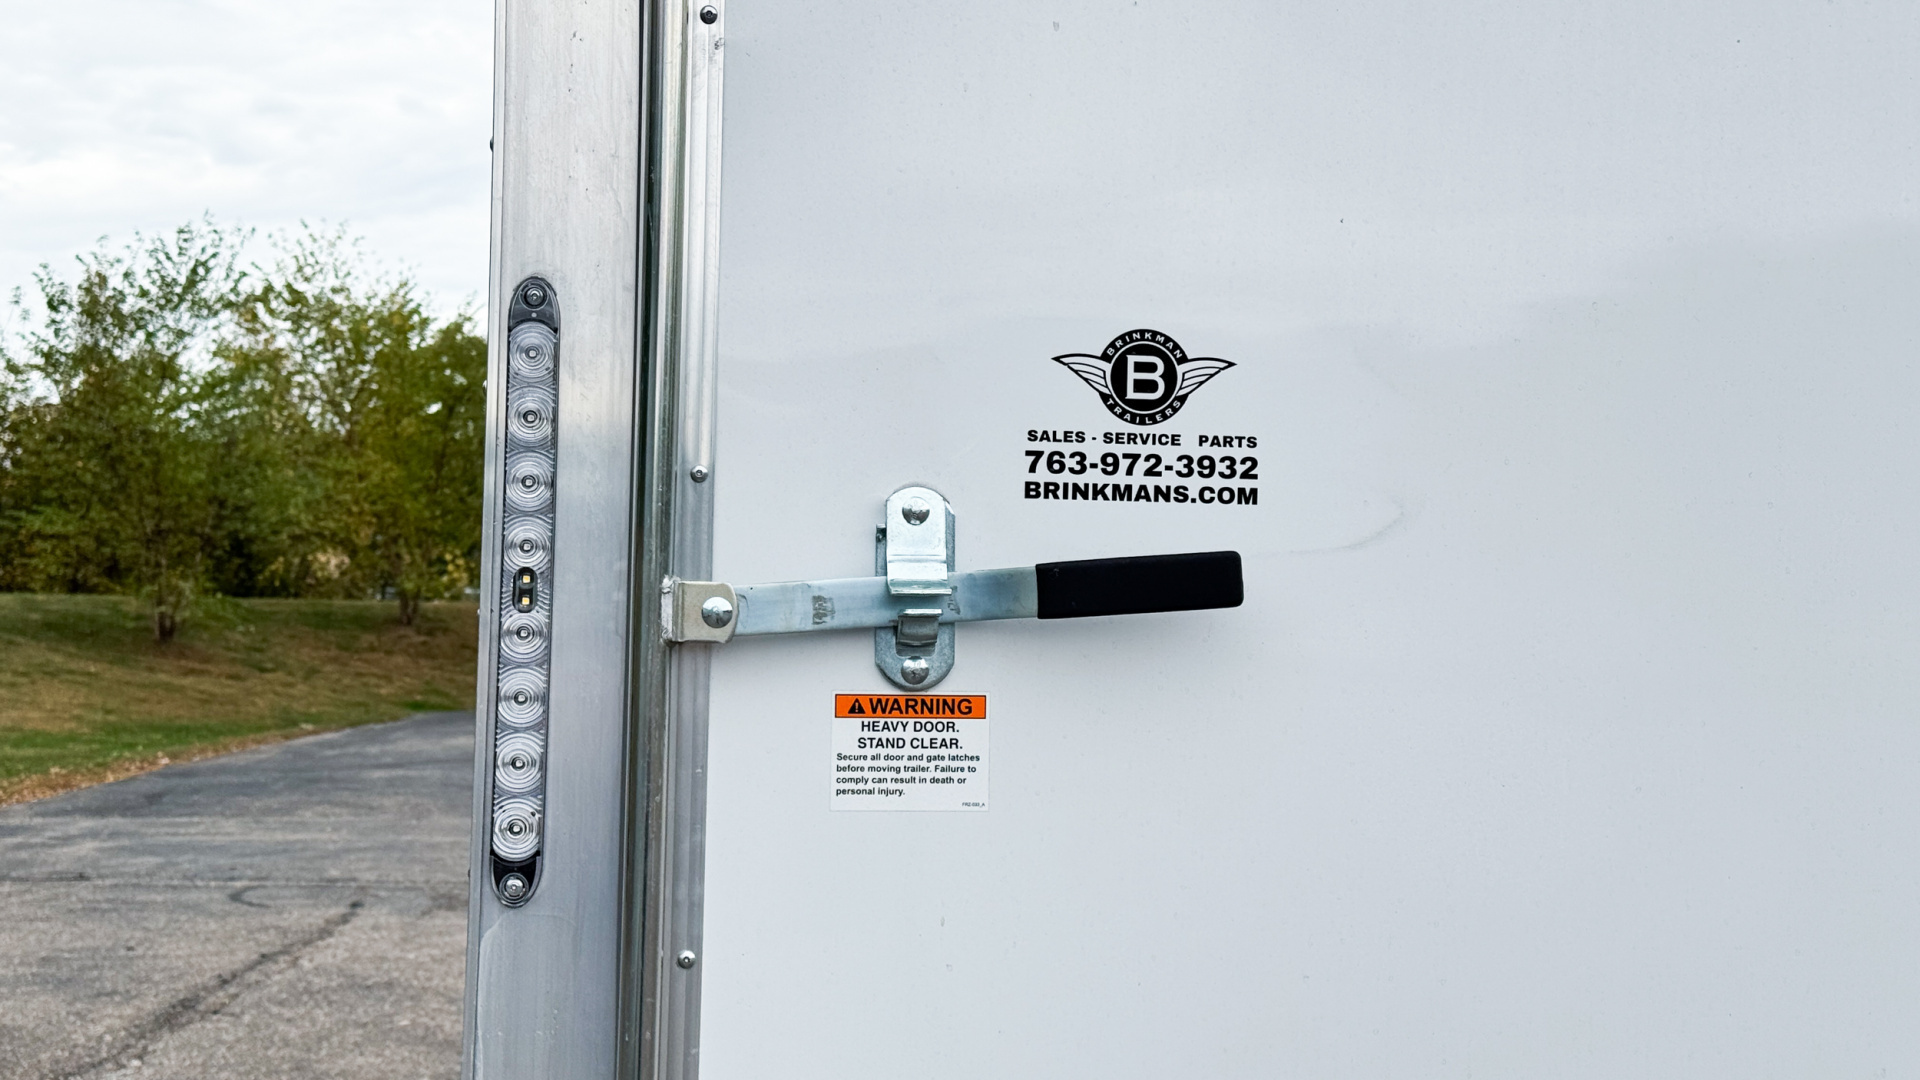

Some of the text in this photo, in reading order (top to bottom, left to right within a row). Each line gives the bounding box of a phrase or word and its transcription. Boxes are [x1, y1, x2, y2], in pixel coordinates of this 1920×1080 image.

[1106, 332, 1183, 360] BRINKMAN
[1125, 354, 1165, 400] B
[1106, 398, 1181, 424] TRAILERS
[1027, 430, 1086, 443] SALES
[1102, 432, 1181, 446] SERVICE
[1198, 435, 1258, 448] PARTS
[1025, 450, 1258, 480] 763-972-3932
[1024, 481, 1258, 505] BRINKMANS.COM
[869, 698, 972, 715] WARNING
[861, 721, 960, 733] HEAVY DOOR.
[857, 737, 963, 749] STAND CLEAR.
[836, 753, 980, 763] Secure all door and gate latches
[836, 764, 865, 772] before
[867, 765, 901, 774] moving
[934, 765, 965, 773] Failure
[836, 776, 869, 785] comply
[890, 776, 916, 784] result
[918, 776, 927, 784] in
[929, 776, 955, 784] death
[836, 787, 906, 797] personal injury.
